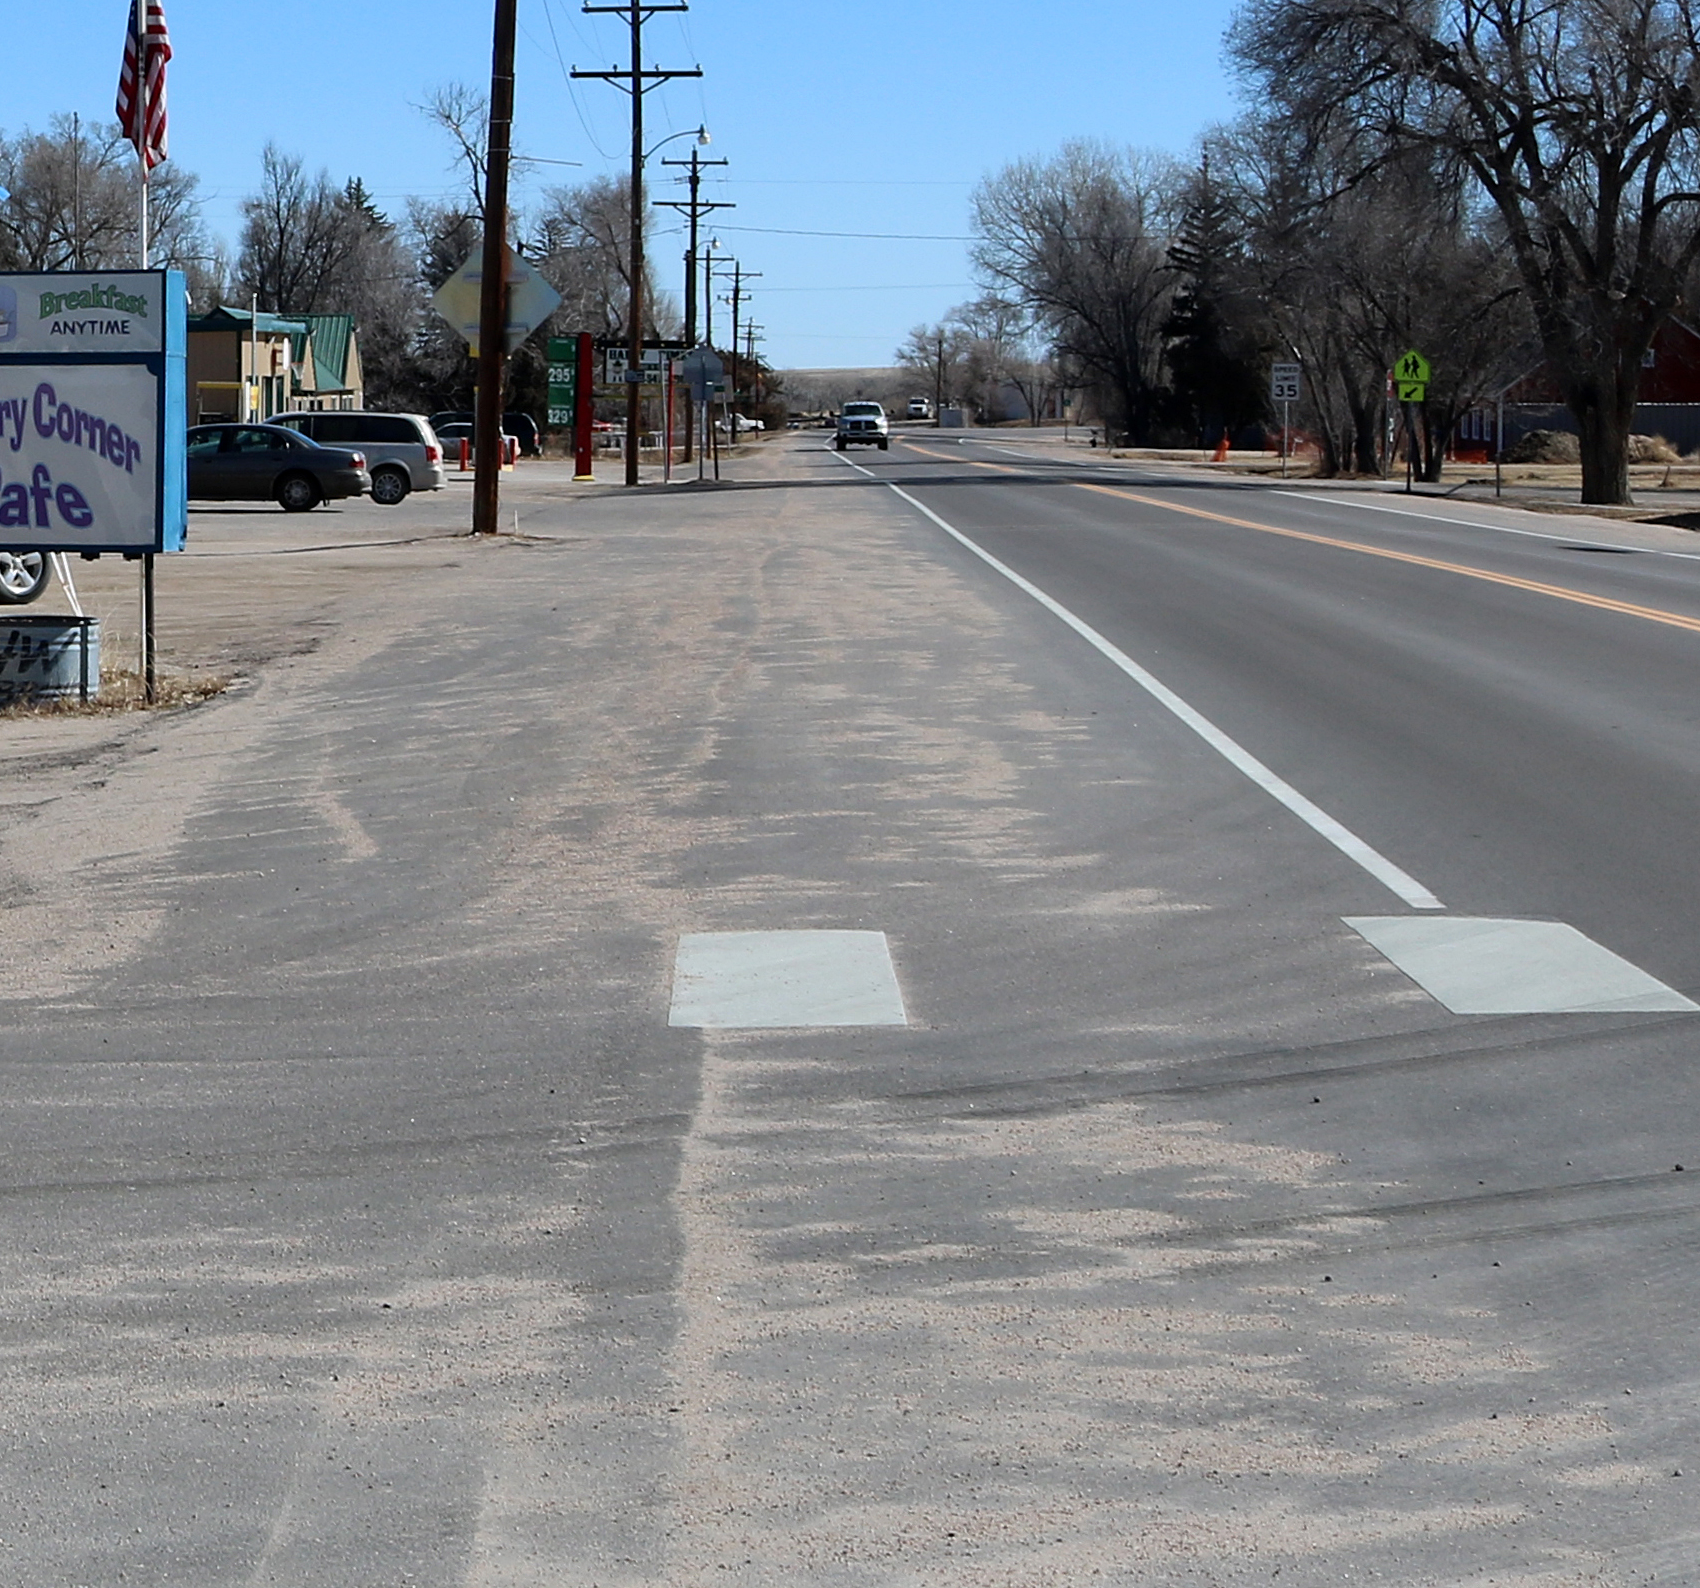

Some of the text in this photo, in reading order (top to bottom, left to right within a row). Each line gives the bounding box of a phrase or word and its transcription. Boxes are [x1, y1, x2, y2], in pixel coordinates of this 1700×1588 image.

[40, 282, 148, 320] Breakfast
[50, 319, 131, 335] ANYTIME
[1274, 384, 1297, 397] 35
[33, 382, 142, 475] Corner
